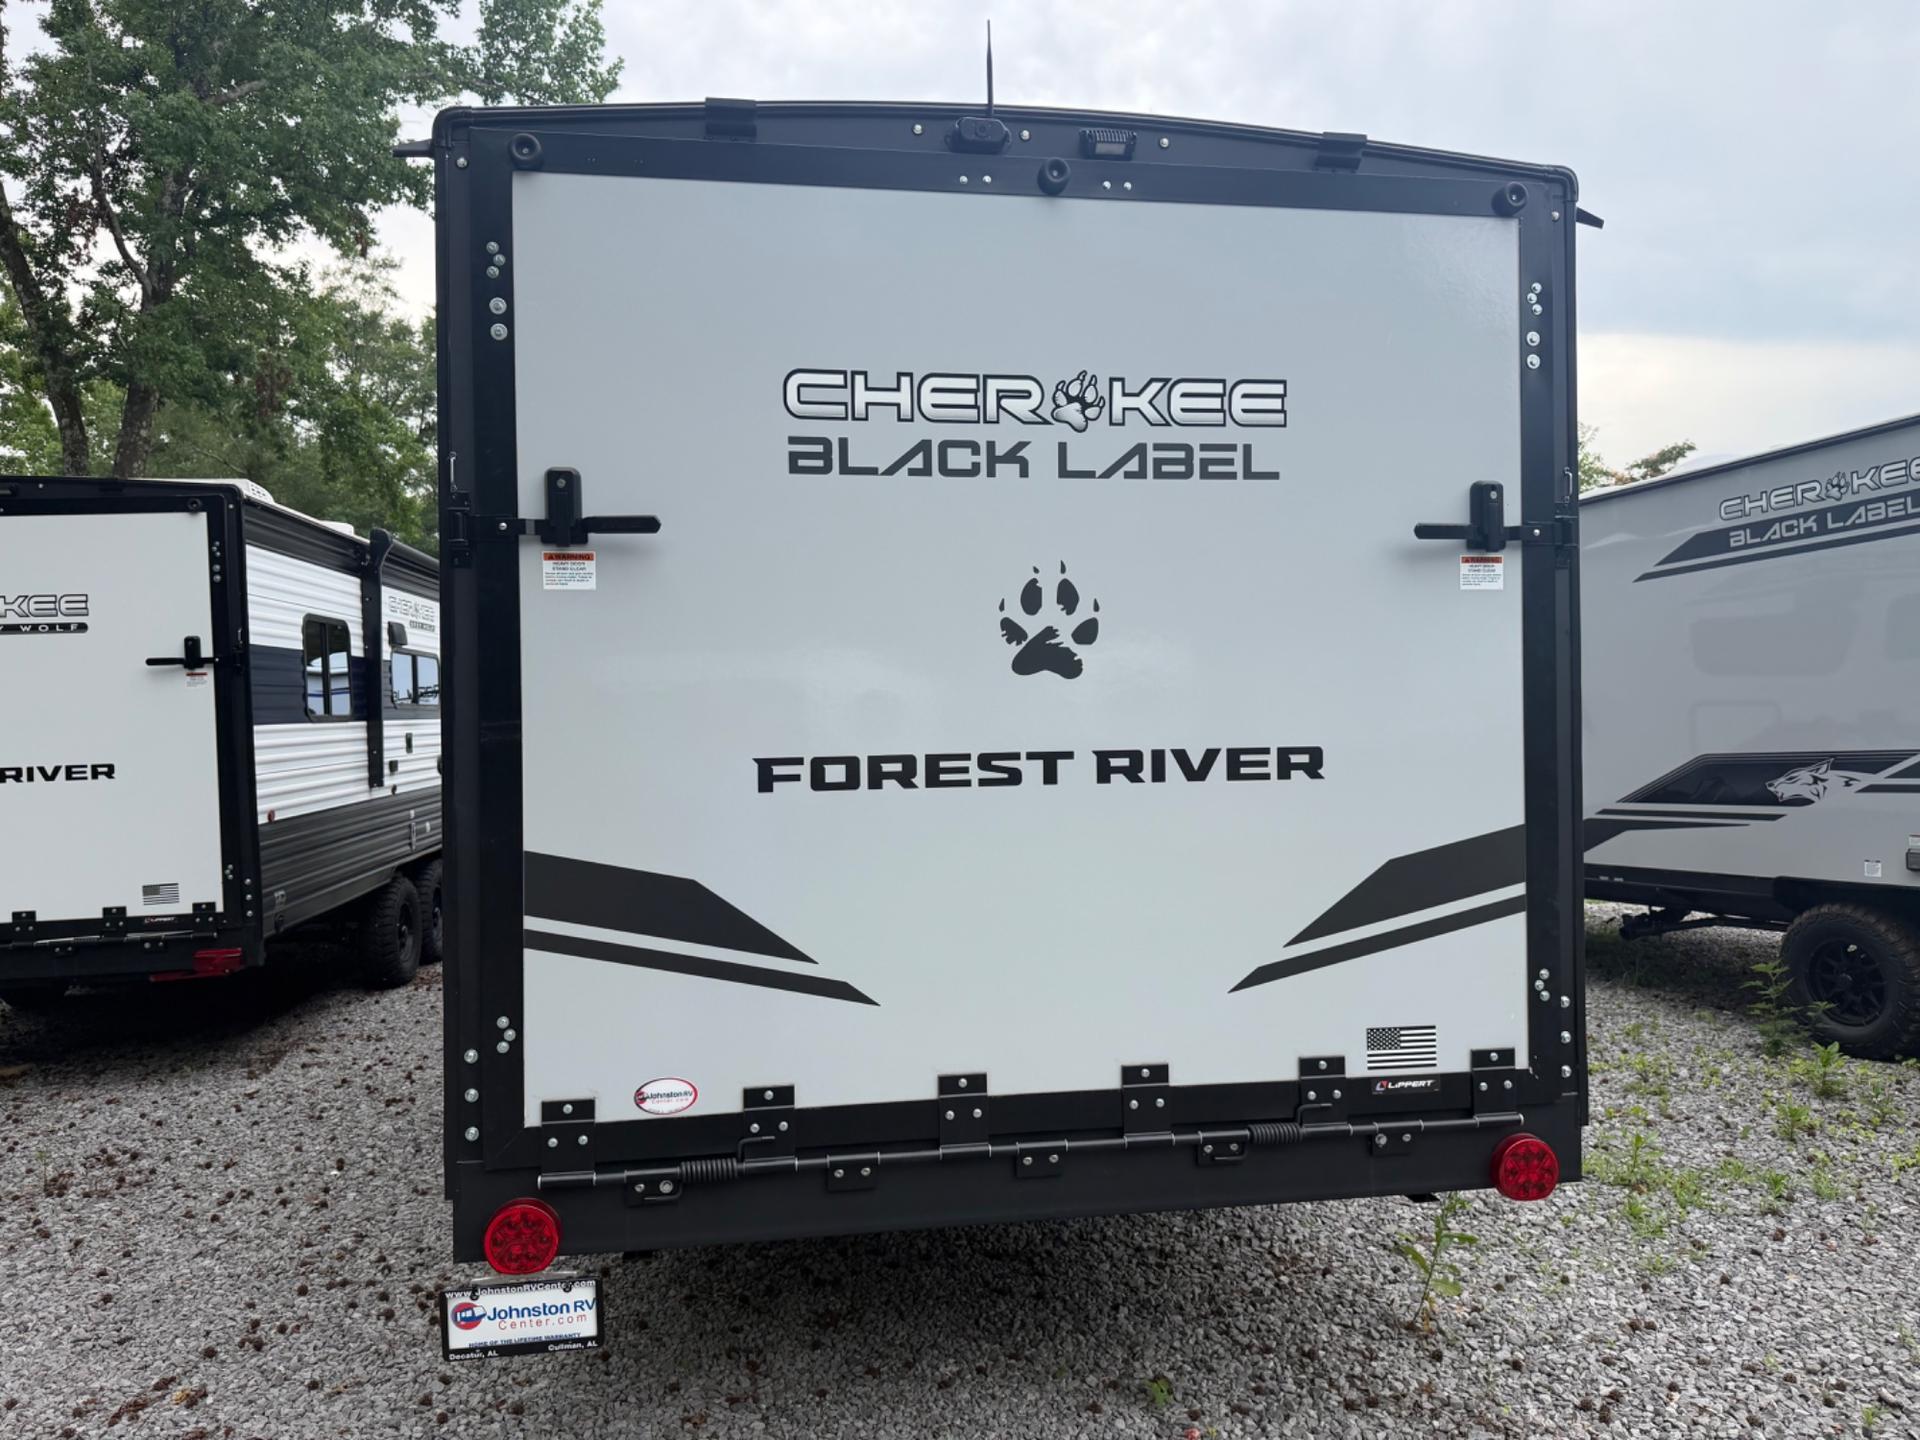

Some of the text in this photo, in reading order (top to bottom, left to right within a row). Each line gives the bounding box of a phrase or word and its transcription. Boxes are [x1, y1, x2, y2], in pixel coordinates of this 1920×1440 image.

[788, 436, 1280, 480] BLACK LABEL
[1729, 496, 1920, 548] BLACK LABEL
[20, 623, 79, 632] WOLF
[0, 763, 116, 783] RIVER
[752, 746, 1326, 793] FOREST RIVER
[487, 1297, 598, 1321] Johnston RV
[498, 1314, 587, 1330] Center.com
